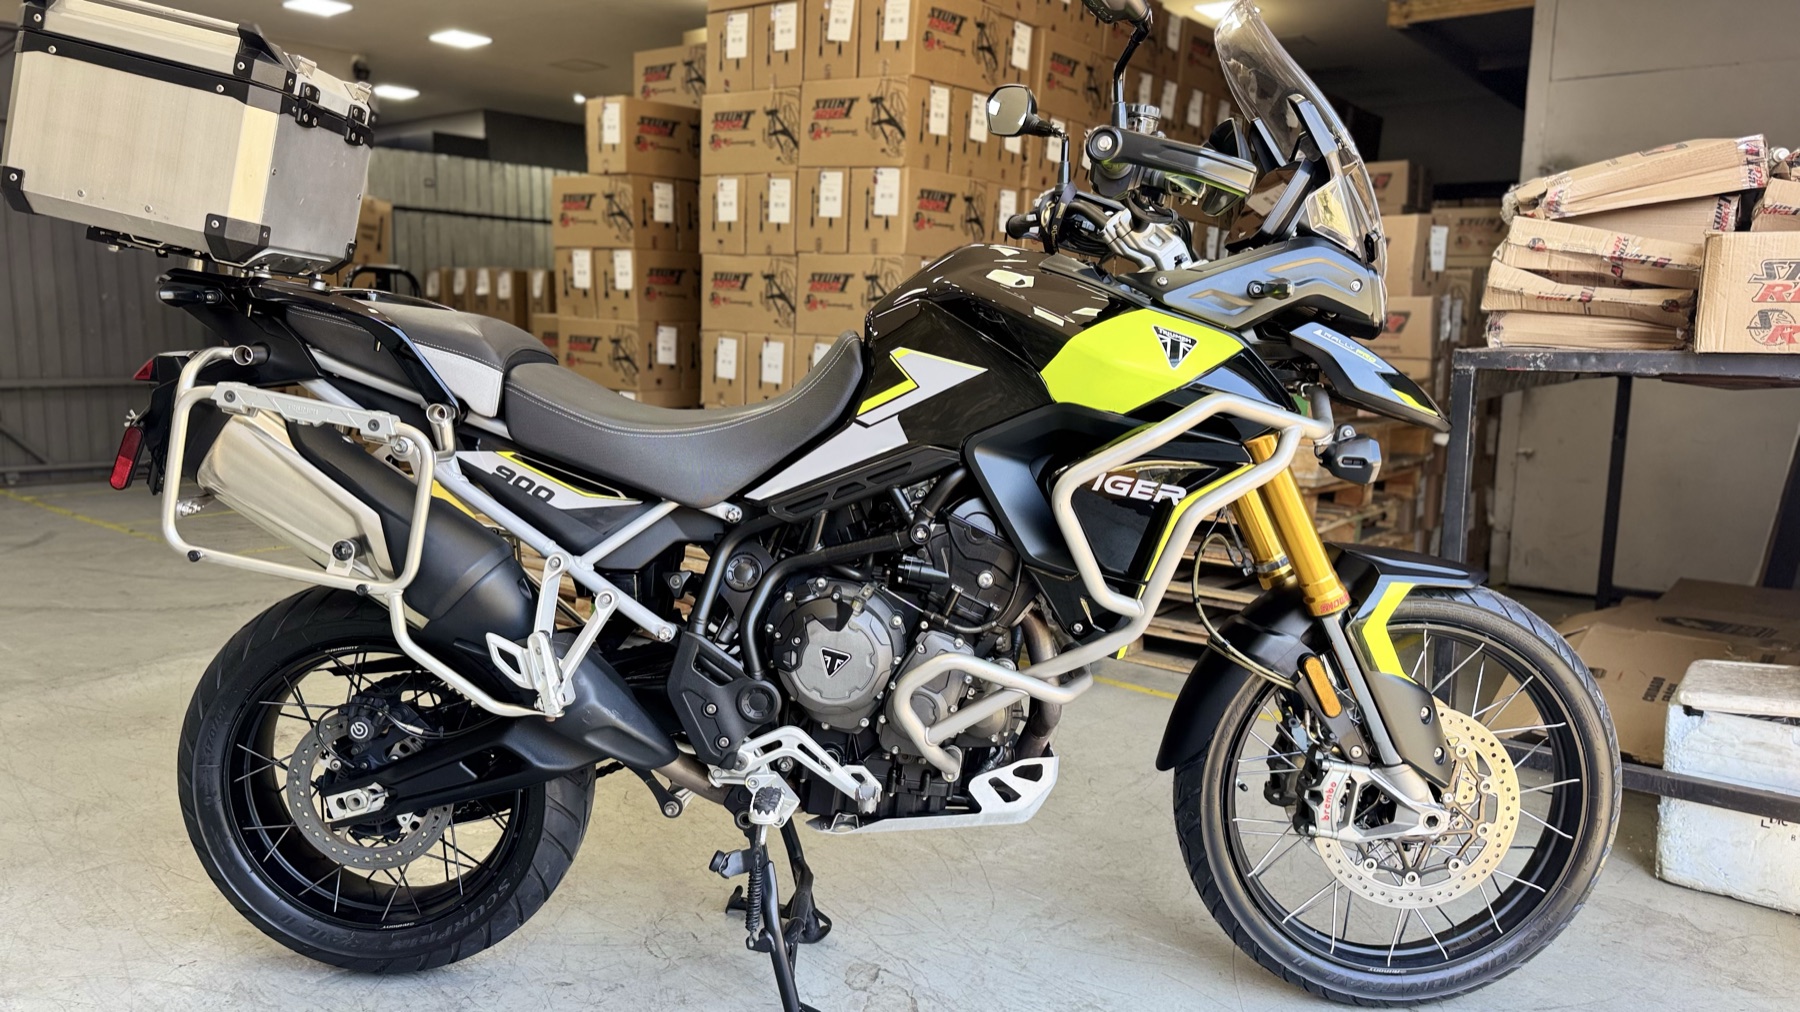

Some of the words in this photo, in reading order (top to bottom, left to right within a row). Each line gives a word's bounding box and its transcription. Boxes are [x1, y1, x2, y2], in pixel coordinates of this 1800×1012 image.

[1158, 327, 1192, 344] TRIUMPH
[1324, 331, 1355, 350] RALLY
[493, 465, 555, 502] 900
[1091, 472, 1187, 506] IGER
[1321, 781, 1337, 822] brembo
